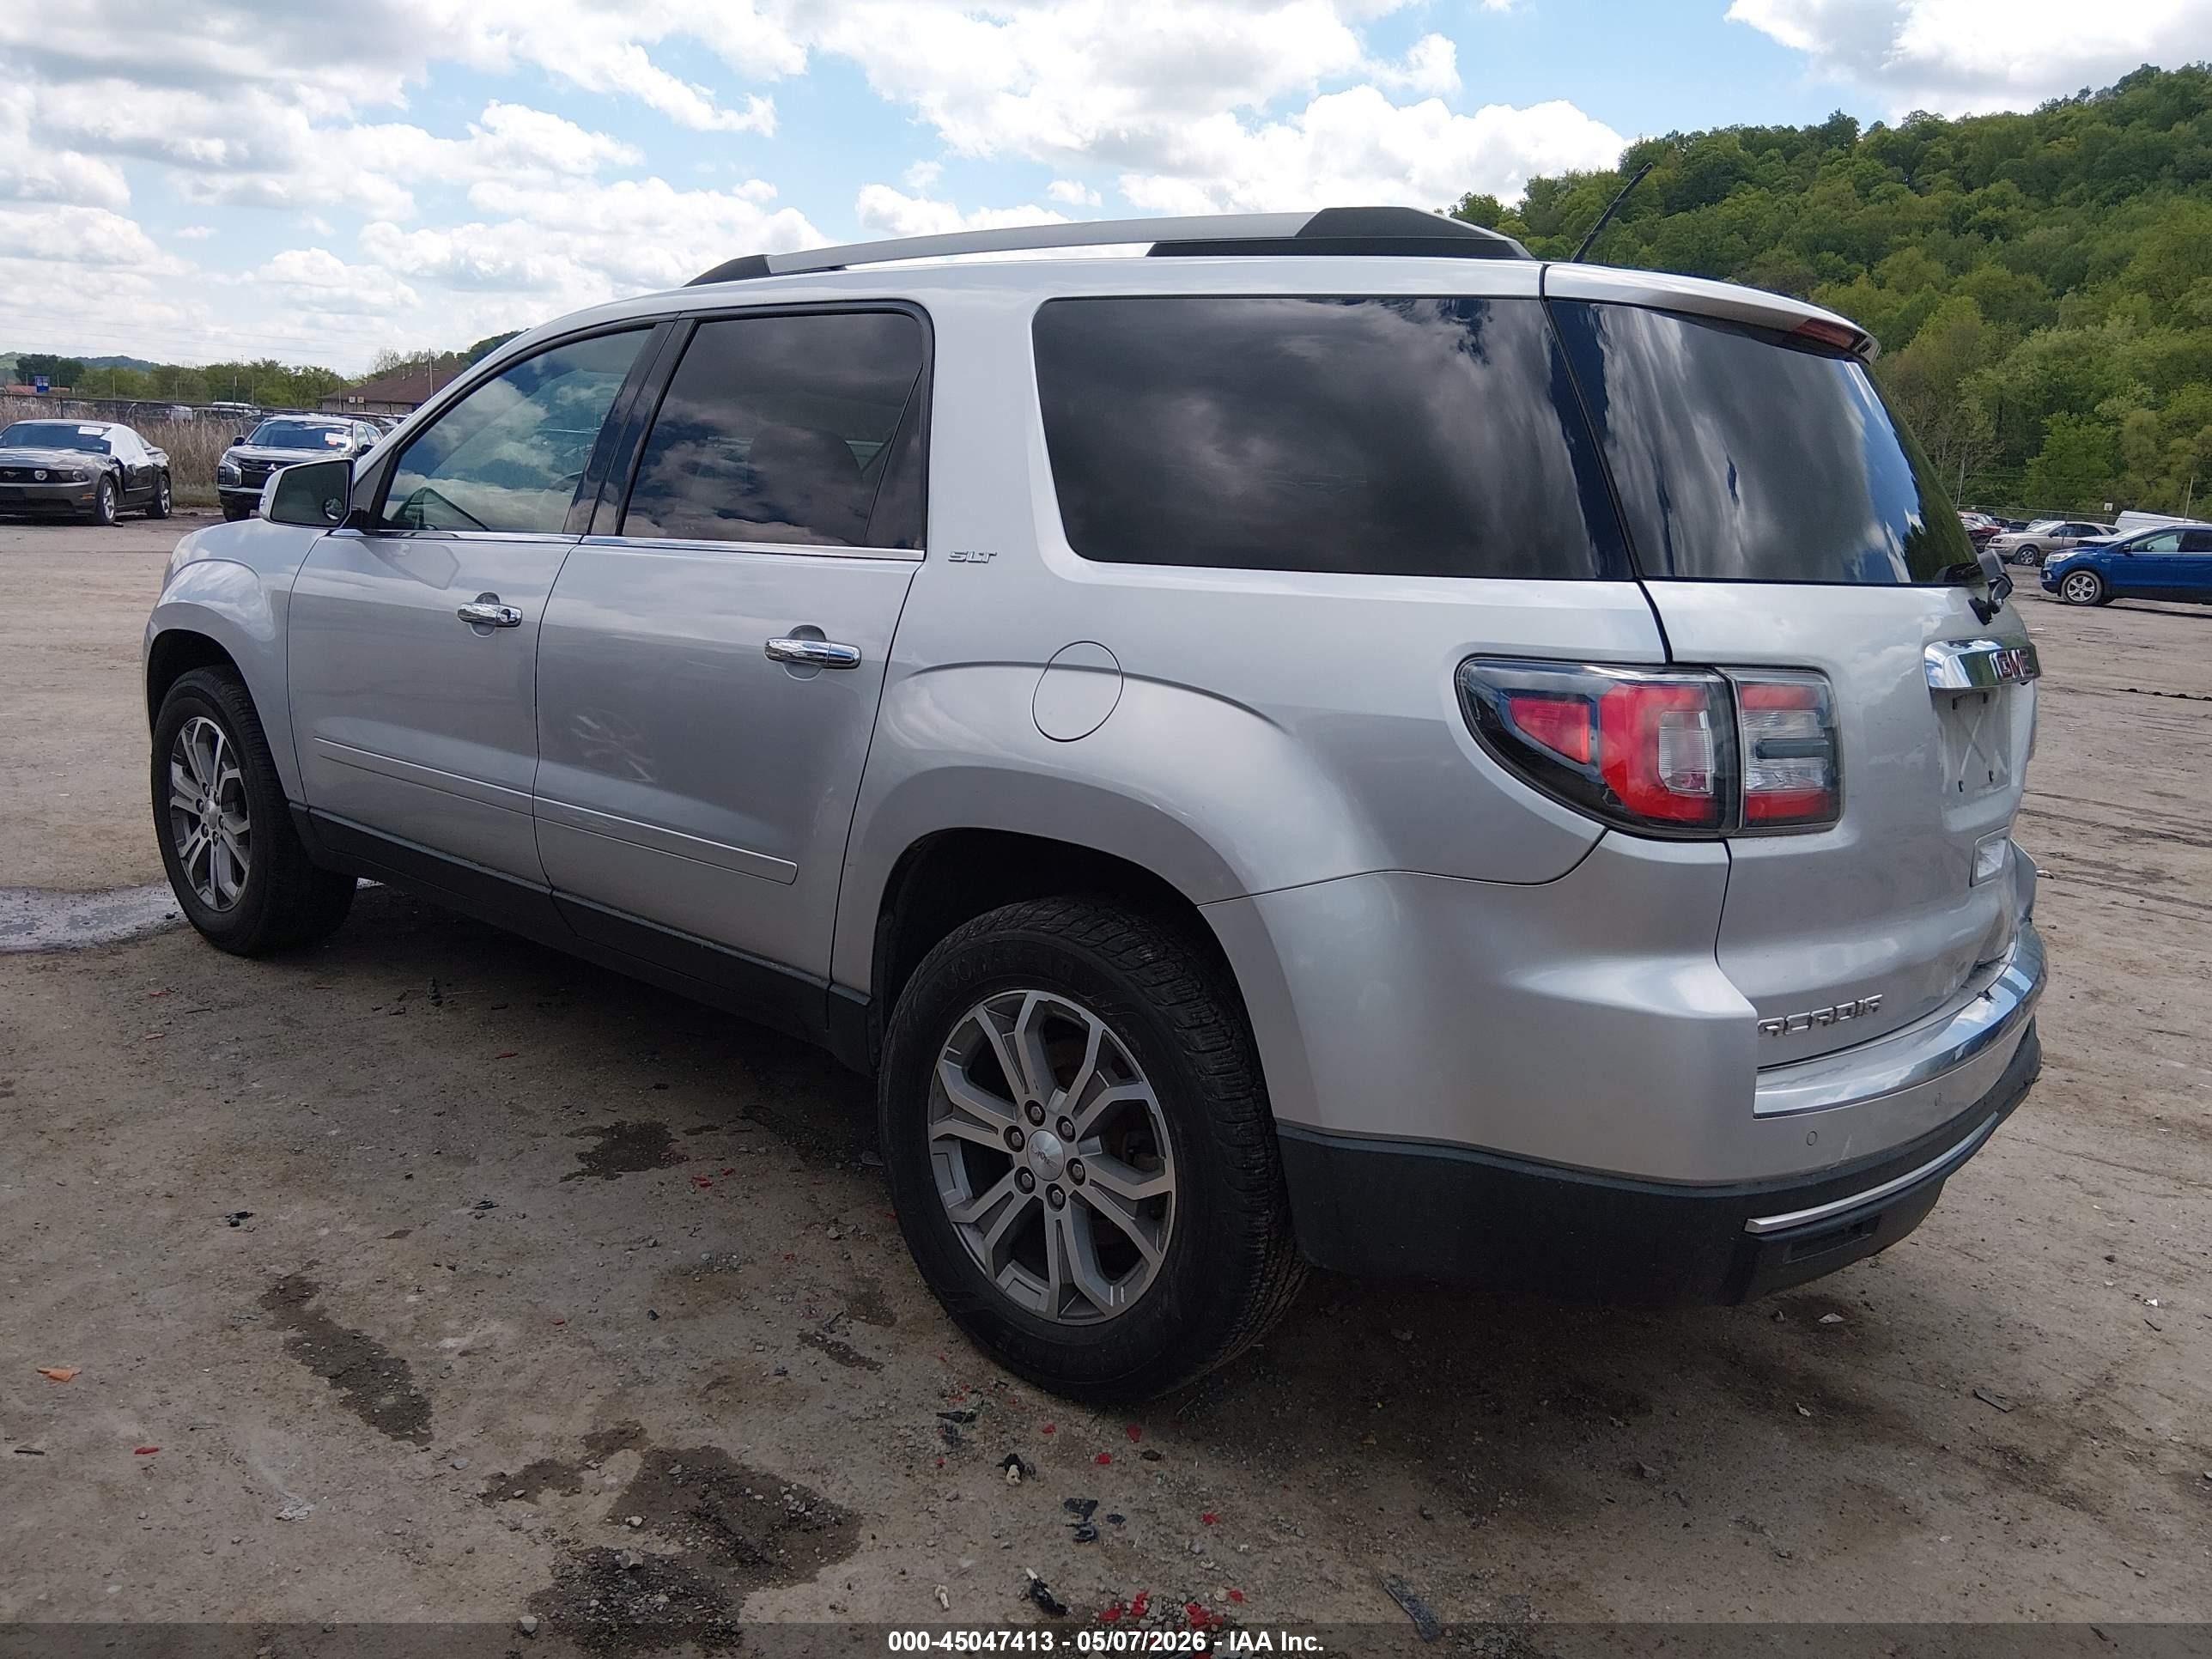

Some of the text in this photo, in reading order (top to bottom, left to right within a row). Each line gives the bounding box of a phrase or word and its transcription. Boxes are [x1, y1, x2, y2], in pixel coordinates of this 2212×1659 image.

[948, 550, 998, 563] SLT
[1990, 648, 2034, 680] GMC
[1758, 994, 1882, 1036] ACADIA
